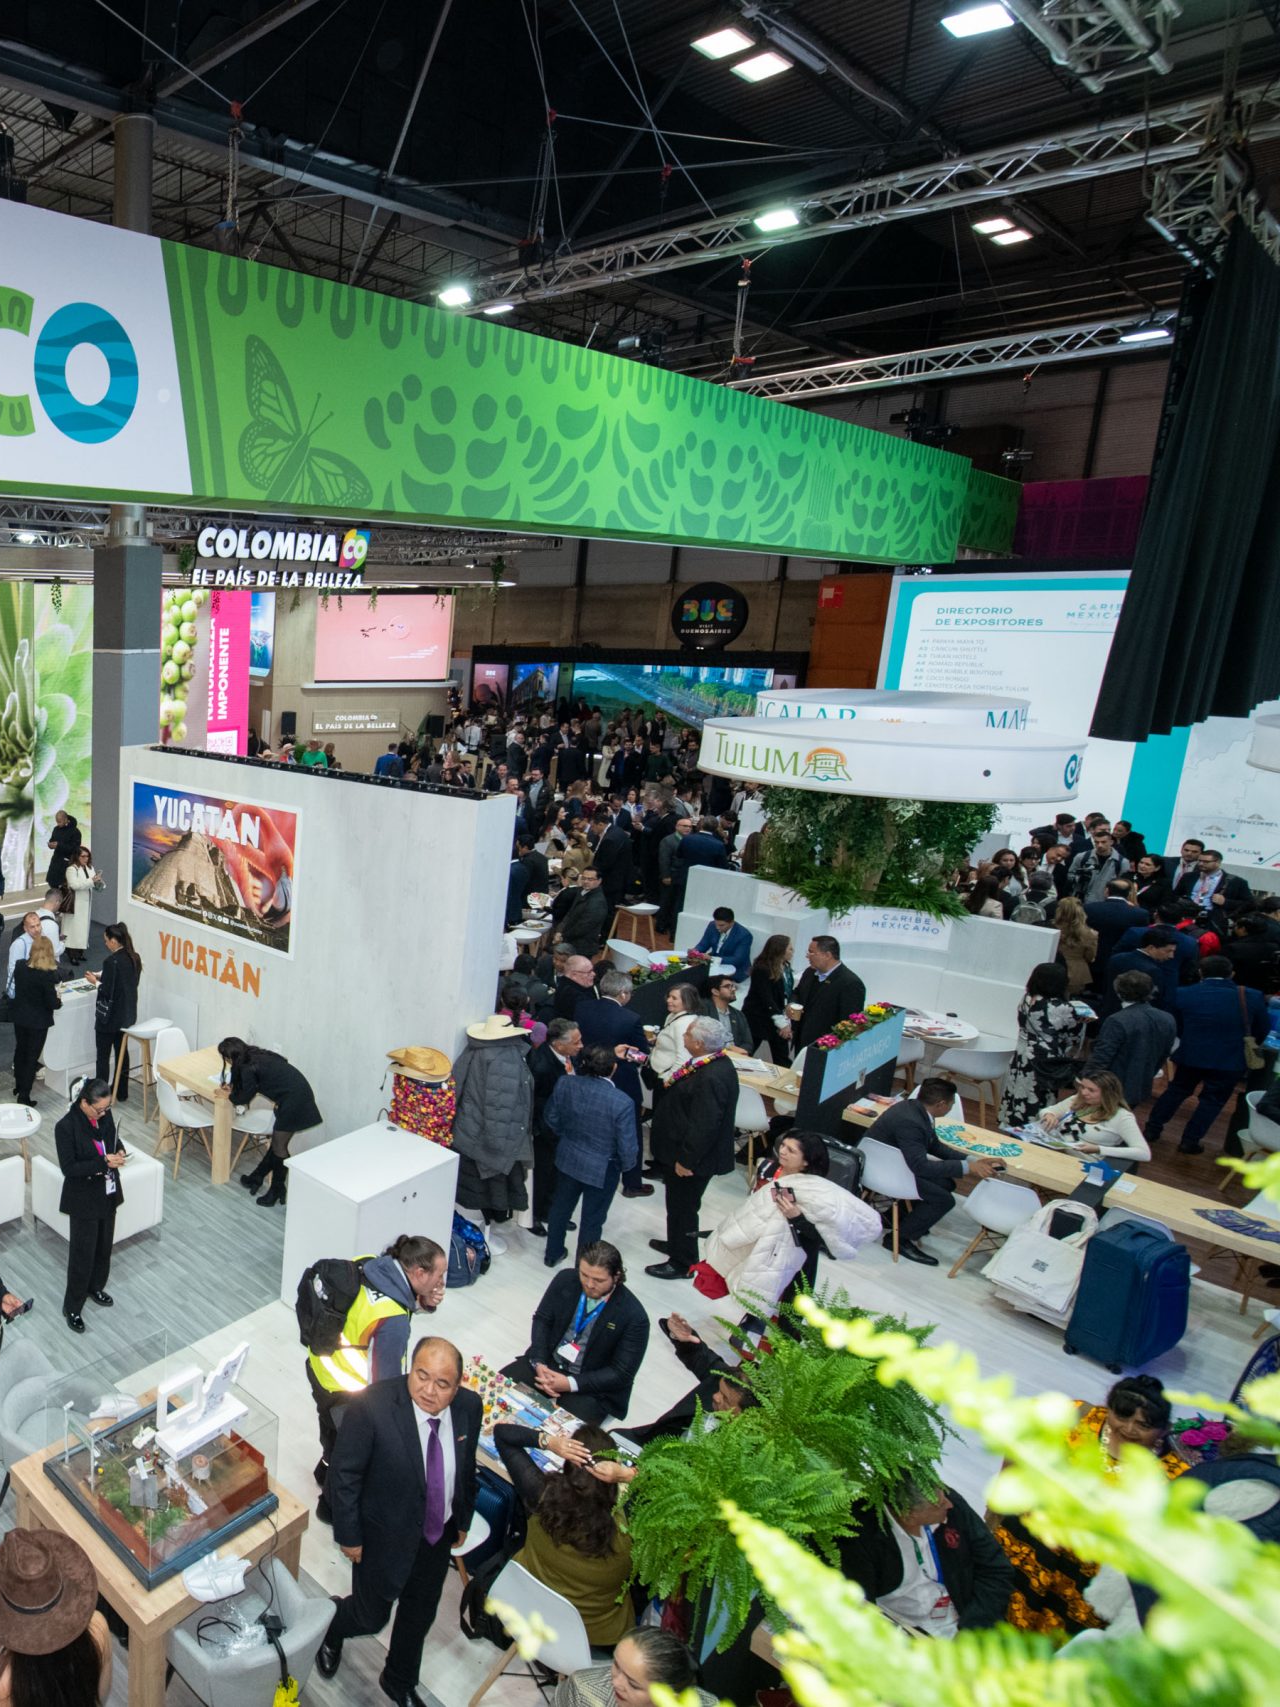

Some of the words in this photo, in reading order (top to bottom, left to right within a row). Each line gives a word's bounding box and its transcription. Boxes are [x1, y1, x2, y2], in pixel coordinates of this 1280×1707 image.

[197, 526, 337, 562] COLOMBIA
[192, 568, 209, 586] EL
[215, 565, 252, 586] PAÍS
[257, 570, 277, 586] DE
[281, 571, 299, 588] LA
[304, 572, 363, 588] BELLEZA
[936, 606, 1014, 616] DIRECTORIO
[935, 618, 952, 626] DE
[954, 618, 1045, 627] EXPOSITORES
[217, 627, 230, 720] IMPONENTE
[881, 913, 932, 925] CARIBE
[871, 920, 940, 935] MEXICANO
